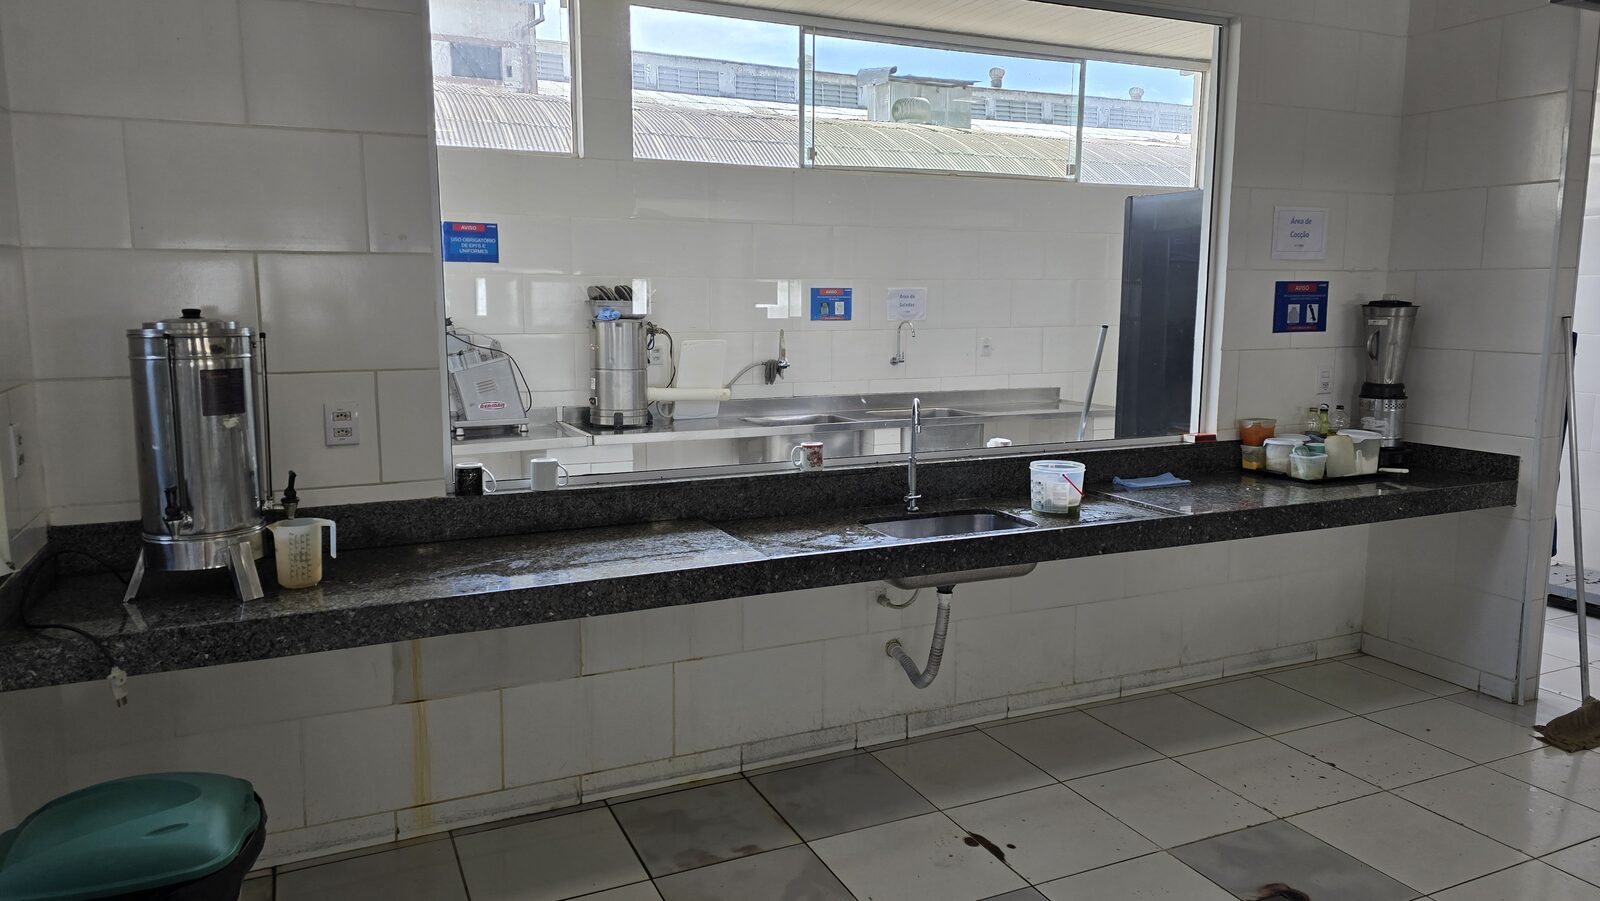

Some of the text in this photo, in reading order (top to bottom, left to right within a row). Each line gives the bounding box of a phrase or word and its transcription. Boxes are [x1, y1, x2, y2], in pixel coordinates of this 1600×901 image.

[1290, 215, 1312, 225] Área de
[1290, 230, 1310, 239] Cocção
